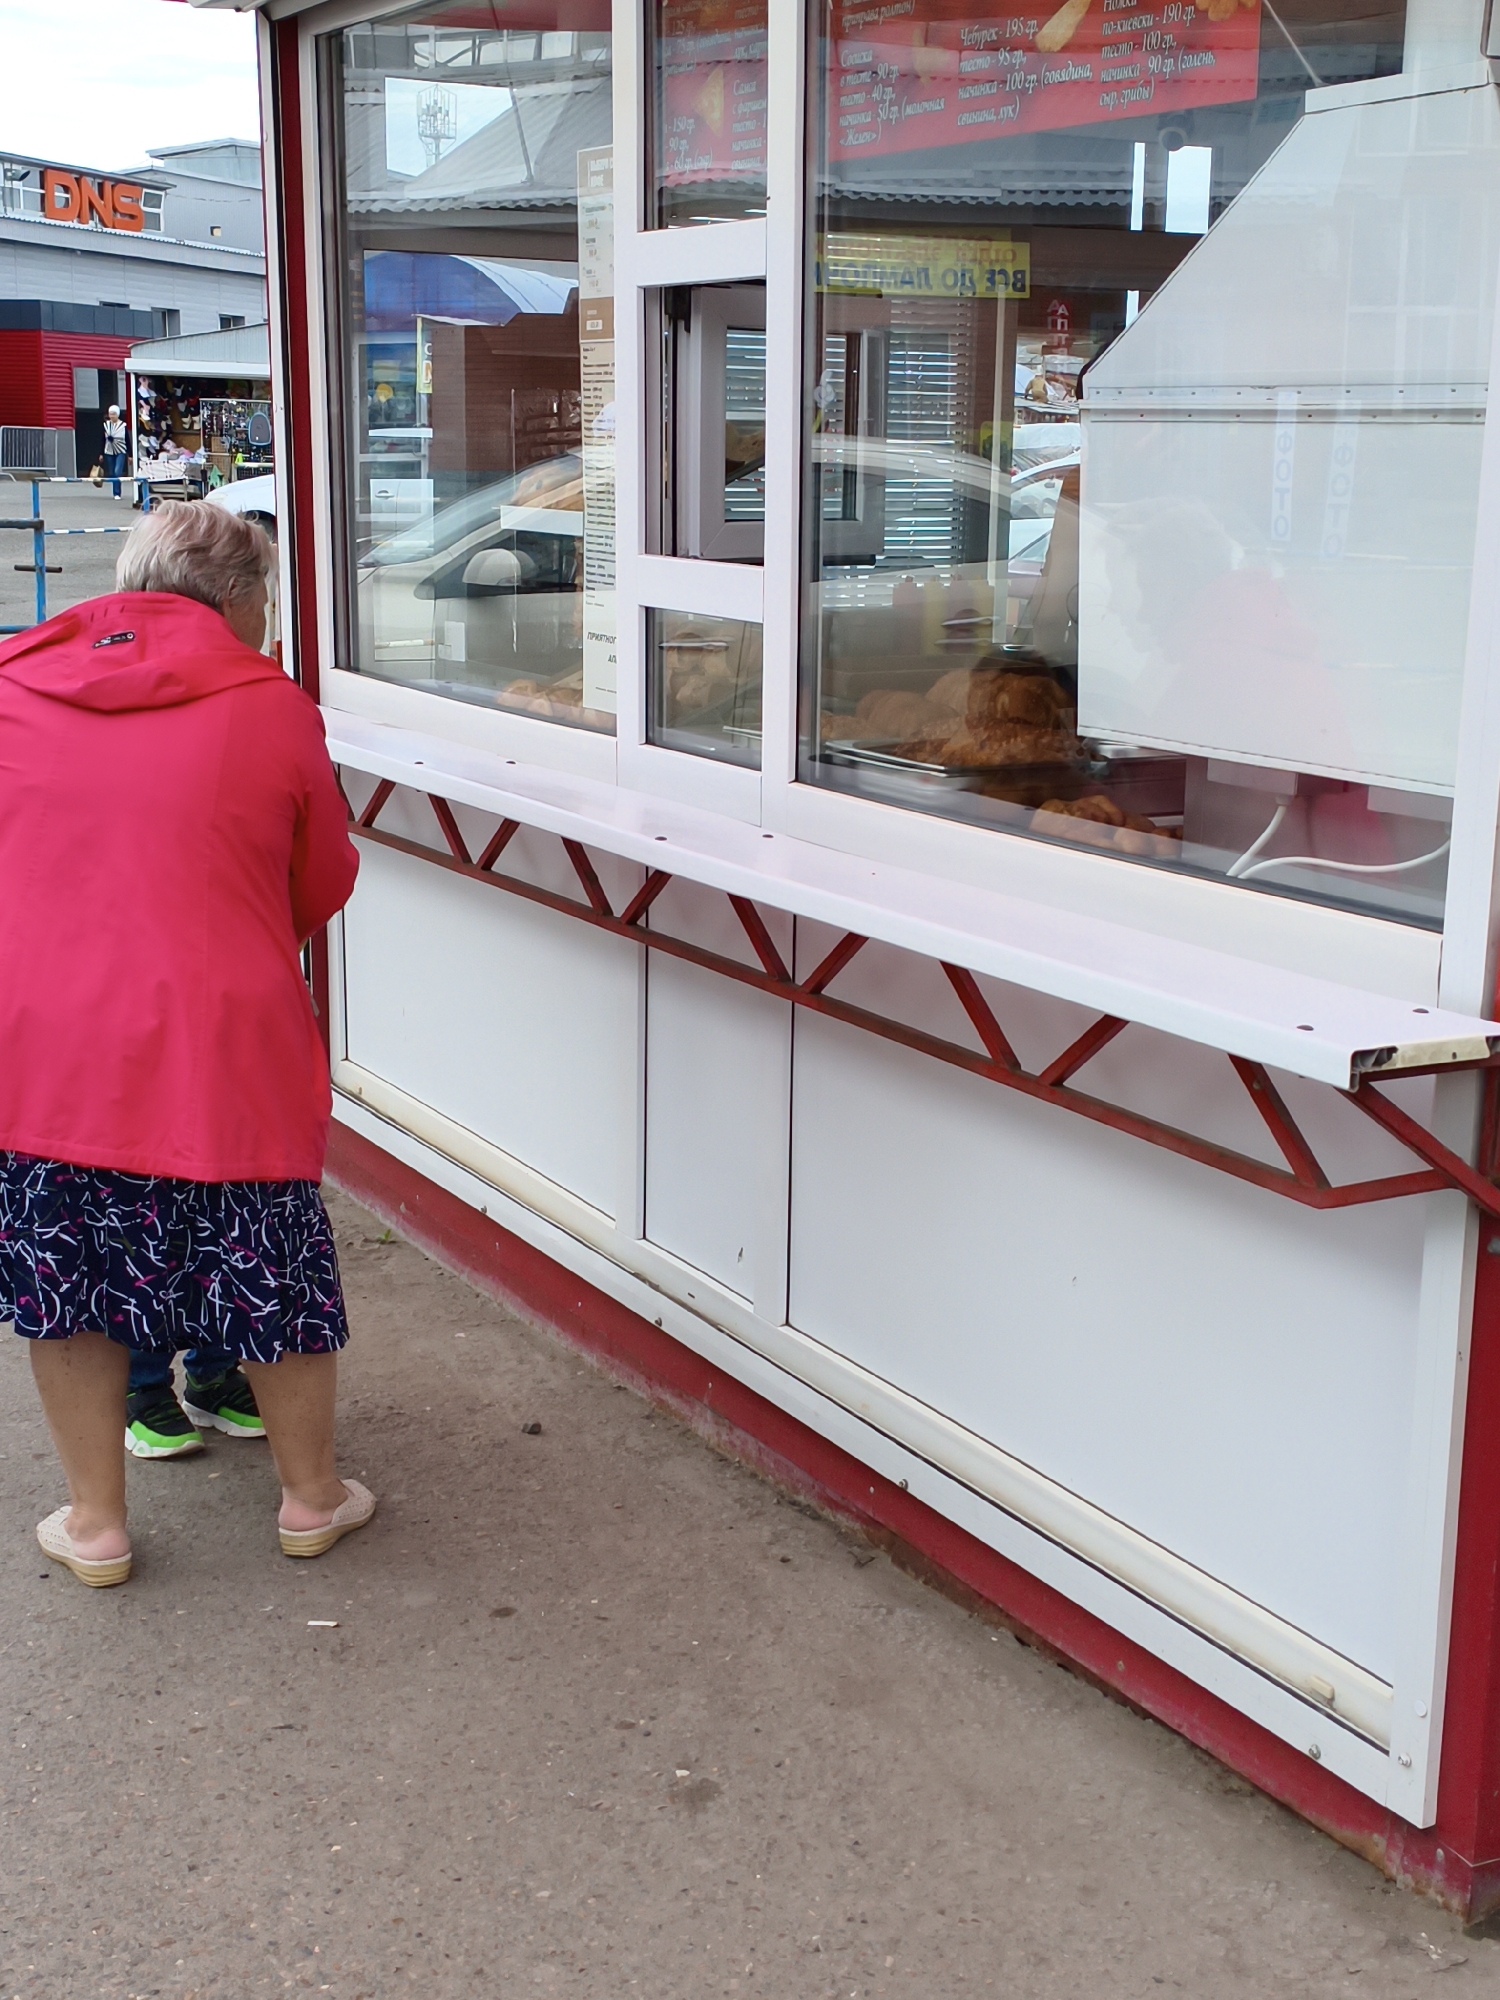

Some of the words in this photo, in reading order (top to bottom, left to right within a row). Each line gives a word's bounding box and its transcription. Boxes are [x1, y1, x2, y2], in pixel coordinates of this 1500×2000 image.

[1102, 14, 1153, 35] по-киевски
[1162, 2, 1182, 24] 190
[1183, 5, 1196, 27] гр.
[961, 25, 998, 50] Чебурек
[1006, 17, 1024, 38] 195
[1025, 20, 1038, 39] гр.
[1102, 42, 1133, 59] тесто
[1142, 31, 1161, 52] 100
[877, 62, 889, 80] 90
[960, 56, 990, 72] тесто
[998, 46, 1010, 66] 95
[1101, 63, 1140, 83] начинка
[1148, 55, 1162, 76] 90
[1163, 58, 1175, 79] гр.
[872, 83, 883, 102] 40
[958, 81, 997, 100] начинка
[1005, 71, 1024, 91] 100
[1025, 73, 1038, 94] гр.
[1041, 61, 1093, 89] (говядина,
[1120, 76, 1155, 109] грибы)
[878, 102, 889, 120] 50
[44, 168, 145, 232] DNS
